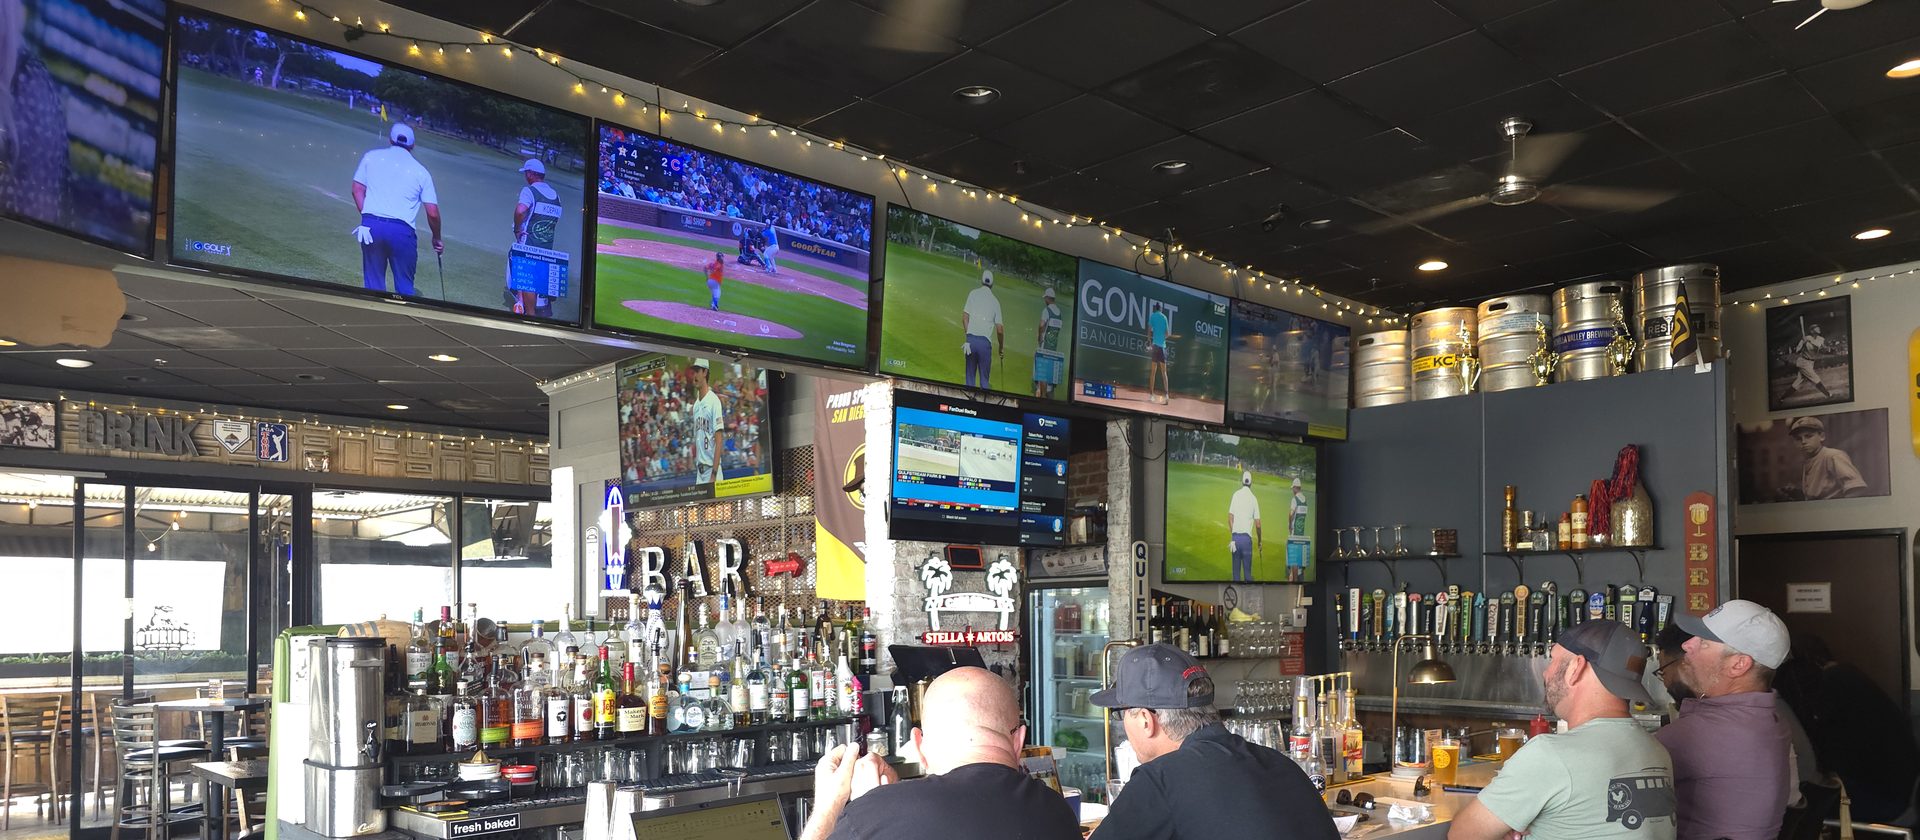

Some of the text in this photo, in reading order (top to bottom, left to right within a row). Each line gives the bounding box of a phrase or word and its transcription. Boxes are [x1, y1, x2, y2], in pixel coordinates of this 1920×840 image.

[631, 150, 638, 158] 4
[662, 158, 668, 167] 2
[204, 242, 225, 252] GOLF
[791, 240, 836, 258] GOODYEAR
[1082, 279, 1178, 336] GONT
[1195, 320, 1224, 338] GONET
[1434, 356, 1452, 366] KC
[826, 392, 851, 408] PROUD
[832, 408, 848, 424] SAN
[949, 406, 964, 414] FanDuel
[79, 411, 200, 457] DRINK
[261, 432, 269, 458] TOUR
[640, 538, 744, 598] BAR
[1689, 543, 1709, 611] BEE
[1136, 543, 1146, 632] QUIET
[926, 631, 1014, 643] STELLA ARTOIS
[602, 699, 614, 714] J&B
[454, 817, 516, 834] fresh baked
